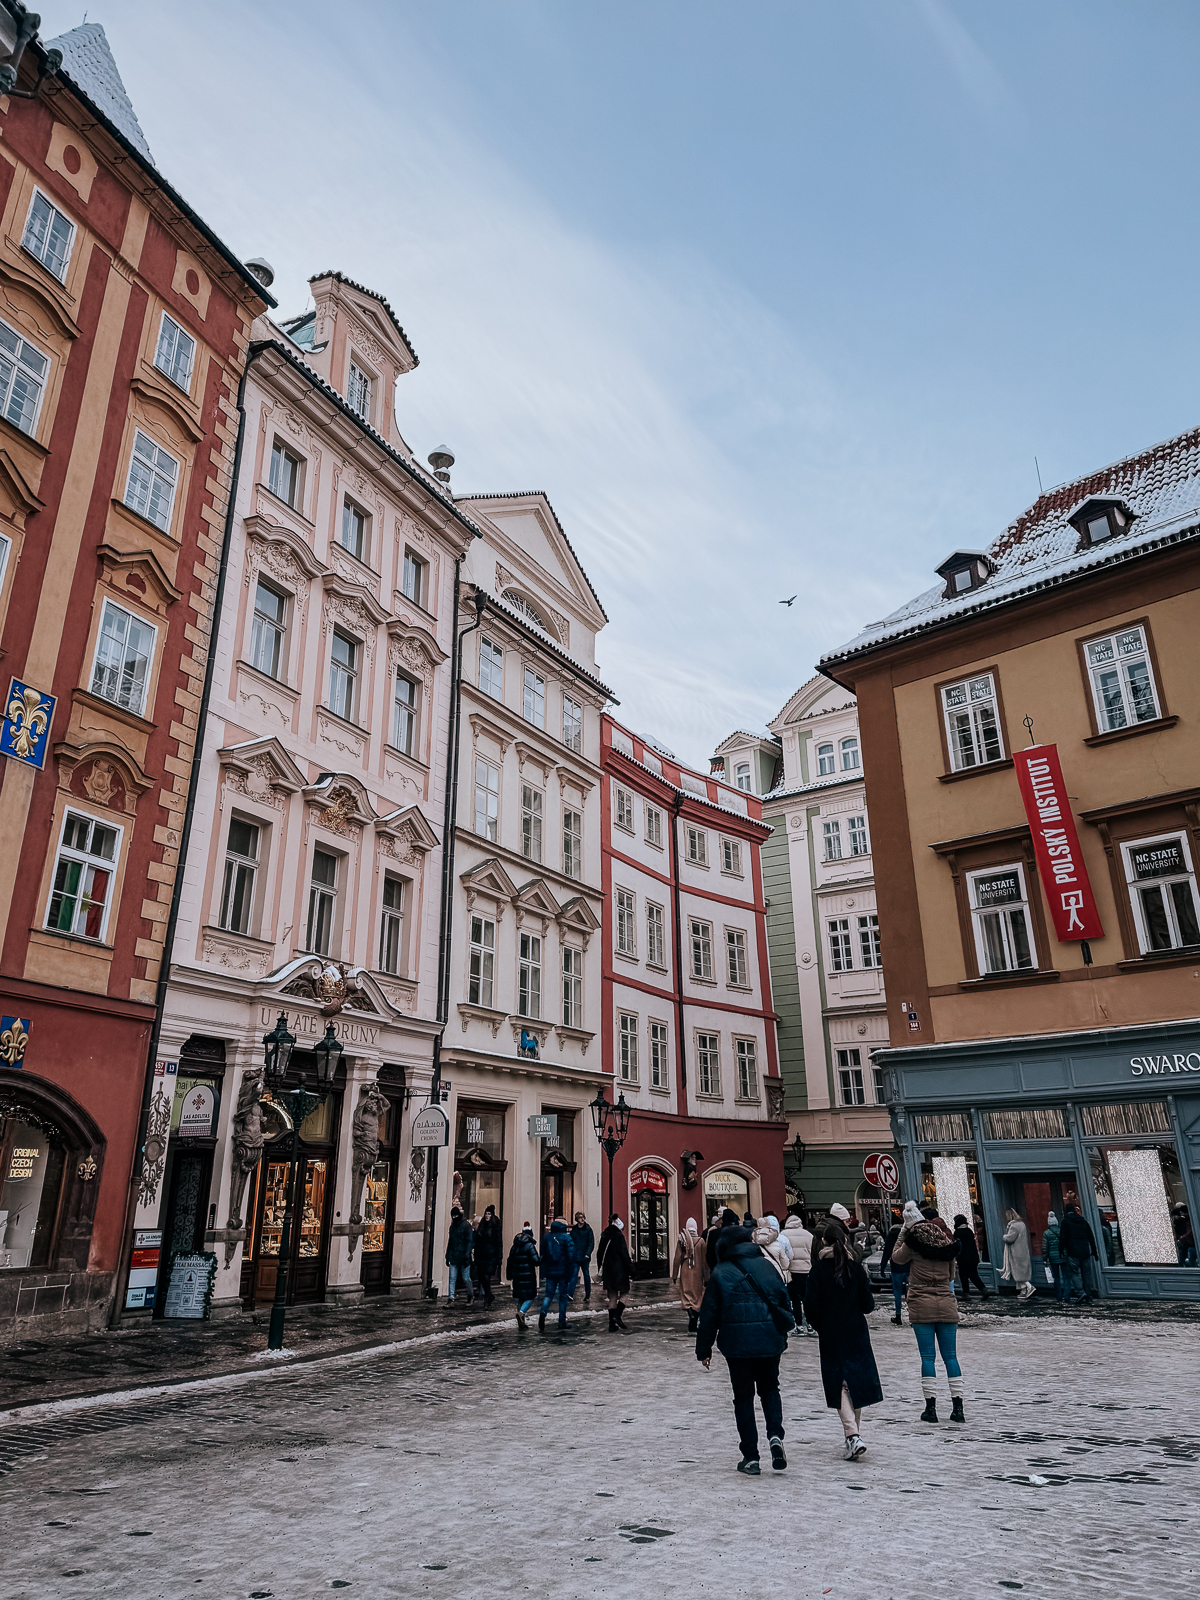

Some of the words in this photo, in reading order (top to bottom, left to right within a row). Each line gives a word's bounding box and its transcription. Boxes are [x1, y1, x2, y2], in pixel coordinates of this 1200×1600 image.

[1122, 635, 1134, 645] NC
[1095, 644, 1106, 653] NC
[1119, 640, 1142, 653] STATE
[1091, 649, 1113, 662] STATE
[975, 681, 985, 690] NC
[951, 689, 961, 698] NC
[971, 686, 991, 699] STATE
[947, 694, 967, 706] STATE
[1026, 757, 1063, 824] INSTITUT
[1040, 828, 1077, 885] POLSKÝ
[1135, 853, 1149, 864] NC
[1150, 847, 1178, 861] STATE
[1137, 856, 1180, 872] UNIVERSITY
[980, 882, 991, 892] NC
[991, 878, 1016, 890] STATE
[980, 887, 1017, 900] UNIVERSITY
[261, 1007, 272, 1026] U
[168, 1064, 175, 1072] 13
[1130, 1052, 1200, 1076] SWARO
[13, 1148, 40, 1158] ORIGINAL
[11, 1158, 33, 1168] CZECH
[10, 1168, 33, 1178] DESIGN
[715, 1174, 731, 1183] DUCK
[708, 1183, 738, 1192] BOUTIQUE
